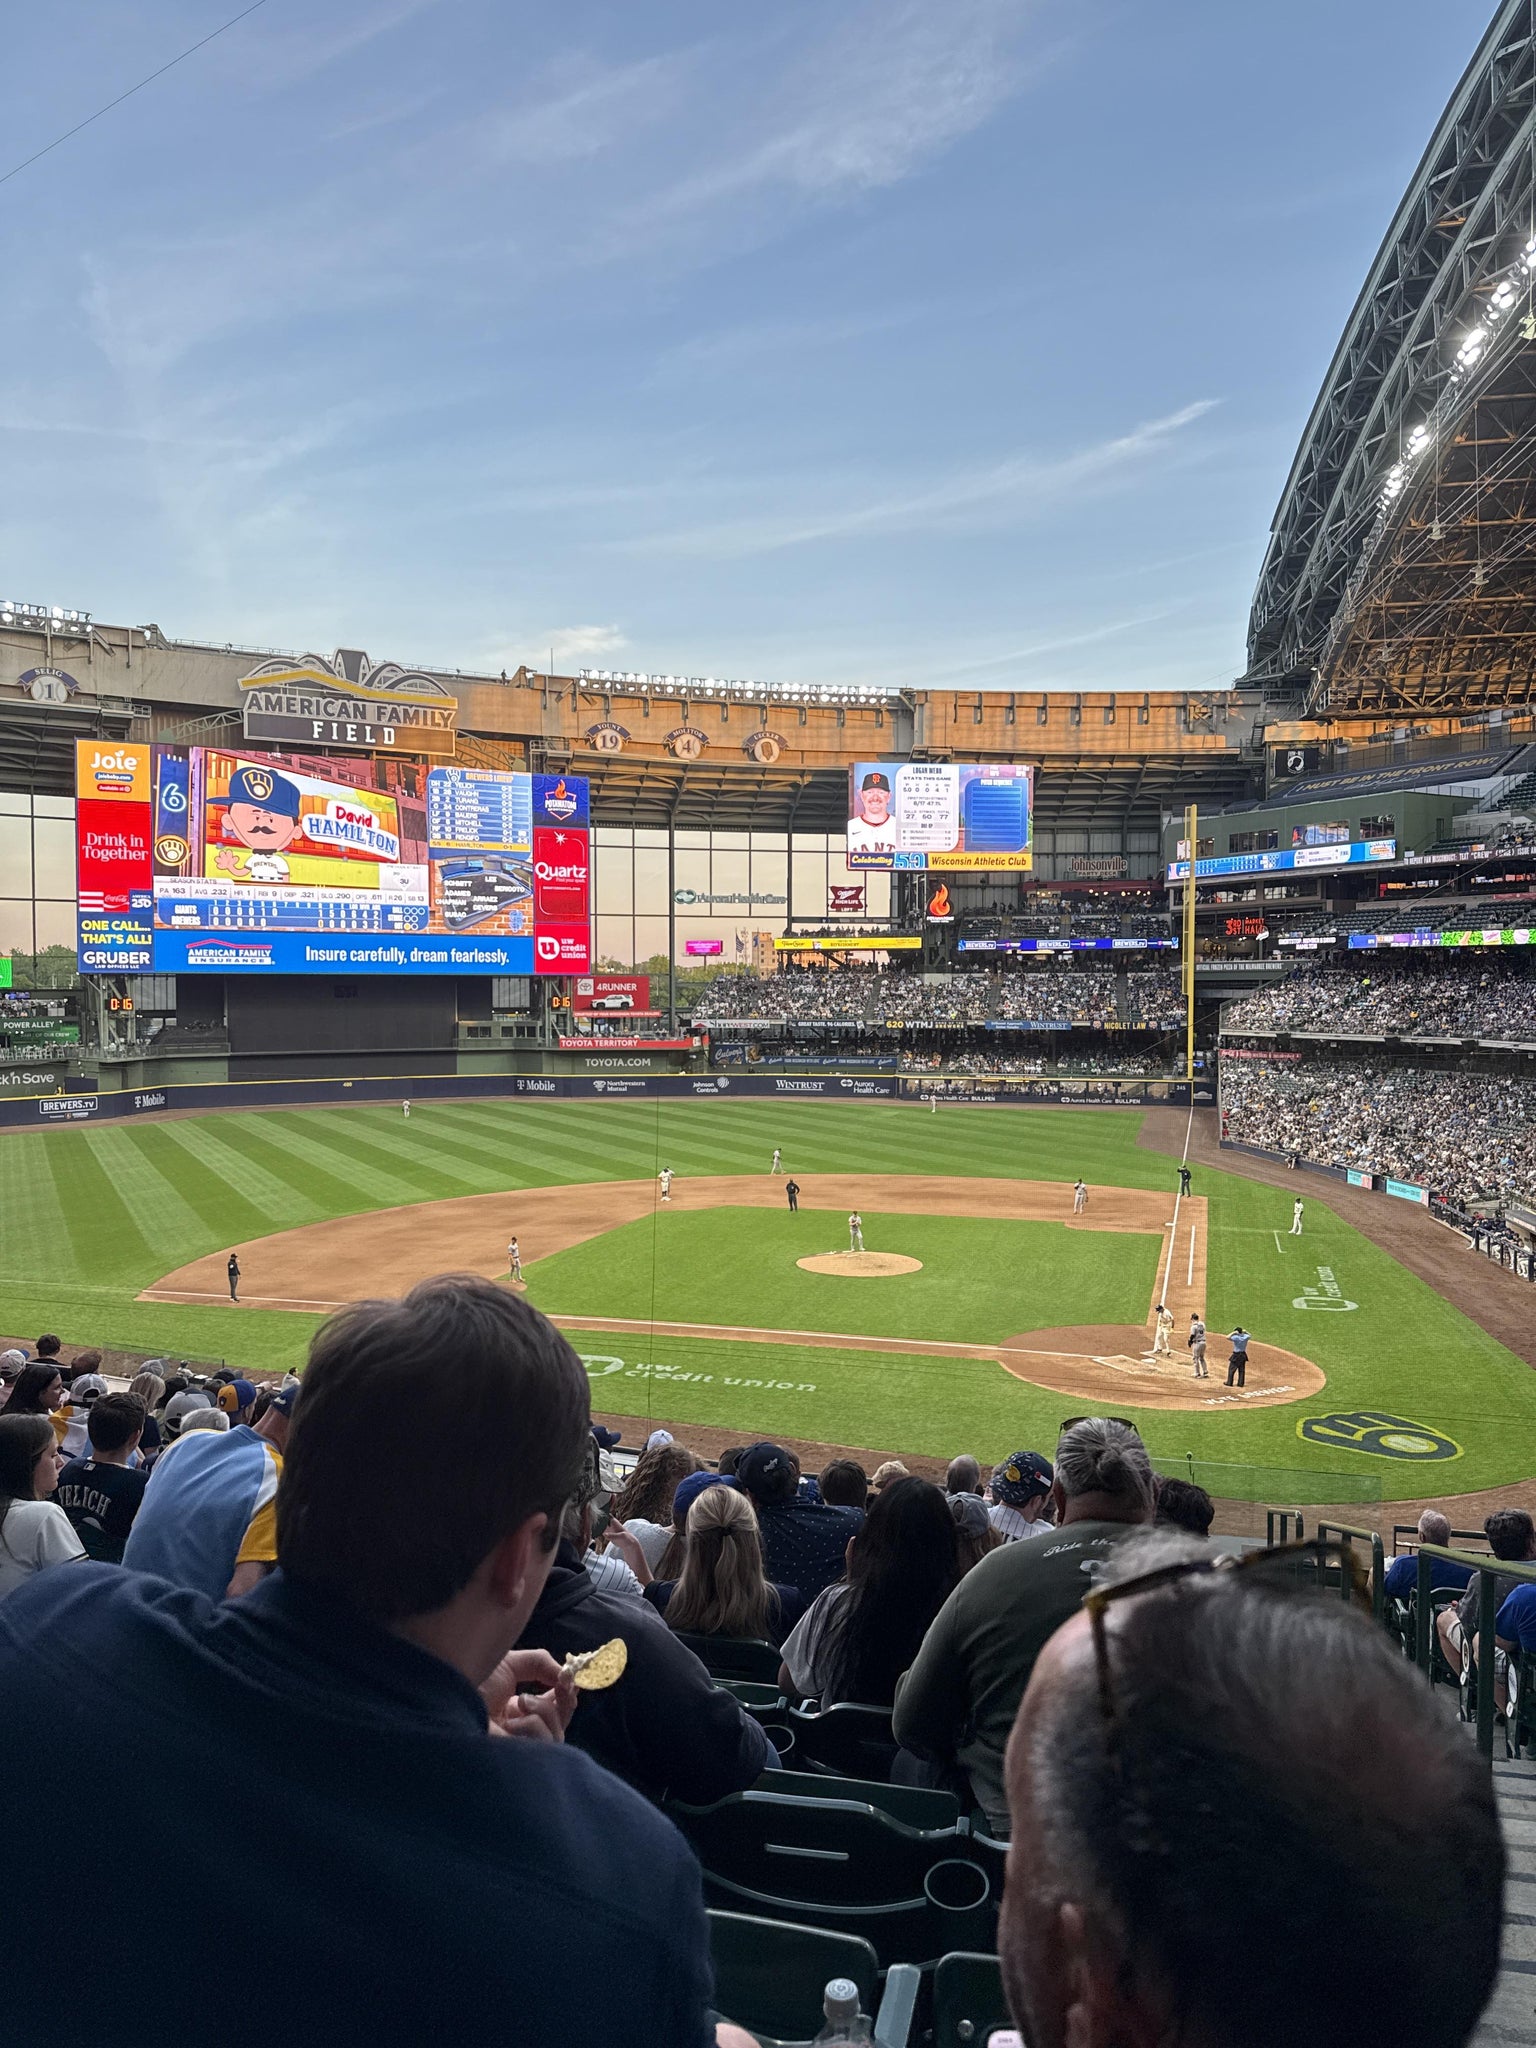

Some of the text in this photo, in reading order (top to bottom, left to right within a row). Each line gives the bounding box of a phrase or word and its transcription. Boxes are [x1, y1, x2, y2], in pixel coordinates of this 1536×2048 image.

[34, 668, 63, 678] SELIG
[44, 683, 54, 700] 1
[248, 693, 453, 729] AMERICAN FAMILY
[312, 721, 395, 744] FIELD
[597, 721, 622, 732] YOUNT
[673, 728, 704, 739] MOLITOR
[753, 732, 780, 741] UECKER
[601, 734, 619, 750] 19
[682, 739, 691, 753] 4
[90, 750, 138, 771] Joie
[1303, 779, 1340, 791] MUST
[1339, 776, 1360, 786] BE
[1360, 774, 1376, 782] IN
[1376, 770, 1402, 780] THE
[1403, 762, 1454, 775] FRONT
[162, 783, 187, 812] 6
[335, 805, 373, 829] David
[86, 832, 144, 848] Drink in
[308, 816, 397, 856] HAMILTON
[82, 845, 149, 862] Together
[1471, 851, 1492, 859] "CREW"
[931, 856, 1027, 866] Wisconsin Athletic Club
[1068, 856, 1128, 871] Johnsonville
[535, 861, 587, 881] Quartz
[172, 887, 186, 895] 163
[300, 891, 315, 899] .321
[334, 892, 351, 900] .290
[131, 899, 152, 908] 250
[435, 898, 467, 906] CHAPMAN
[81, 920, 109, 931] ONE
[81, 933, 153, 945] THAT'S ALL!
[188, 948, 271, 957] AMERICAN FAMILY
[561, 944, 587, 952] credit
[83, 951, 150, 965] GRUBER
[305, 945, 510, 966] Insure carefully, dream fearlessly.
[561, 951, 587, 959] union
[596, 983, 638, 992] 4RUNNER
[110, 998, 133, 1011] 0:16
[552, 996, 571, 1008] 0:16
[886, 1021, 933, 1029] 620 WTMJ
[1104, 1021, 1147, 1030] NICOLET LAW
[561, 1039, 638, 1047] TOYOTA TERRITORY
[715, 1047, 744, 1060] Culver's
[585, 1058, 651, 1067] TOYOTA.COM
[22, 1072, 55, 1084] Save
[526, 1080, 556, 1092] Mobile
[693, 1081, 715, 1089] Johnson
[775, 1079, 825, 1090] WINTRUST
[43, 1100, 95, 1111] BREWERS.TV
[142, 1093, 166, 1108] Mobile
[636, 1361, 682, 1373] uw
[624, 1369, 817, 1393] credit union
[1237, 1385, 1296, 1399] BREWERS
[58, 1484, 112, 1518] YELICH
[1043, 1541, 1083, 1557] Ride
